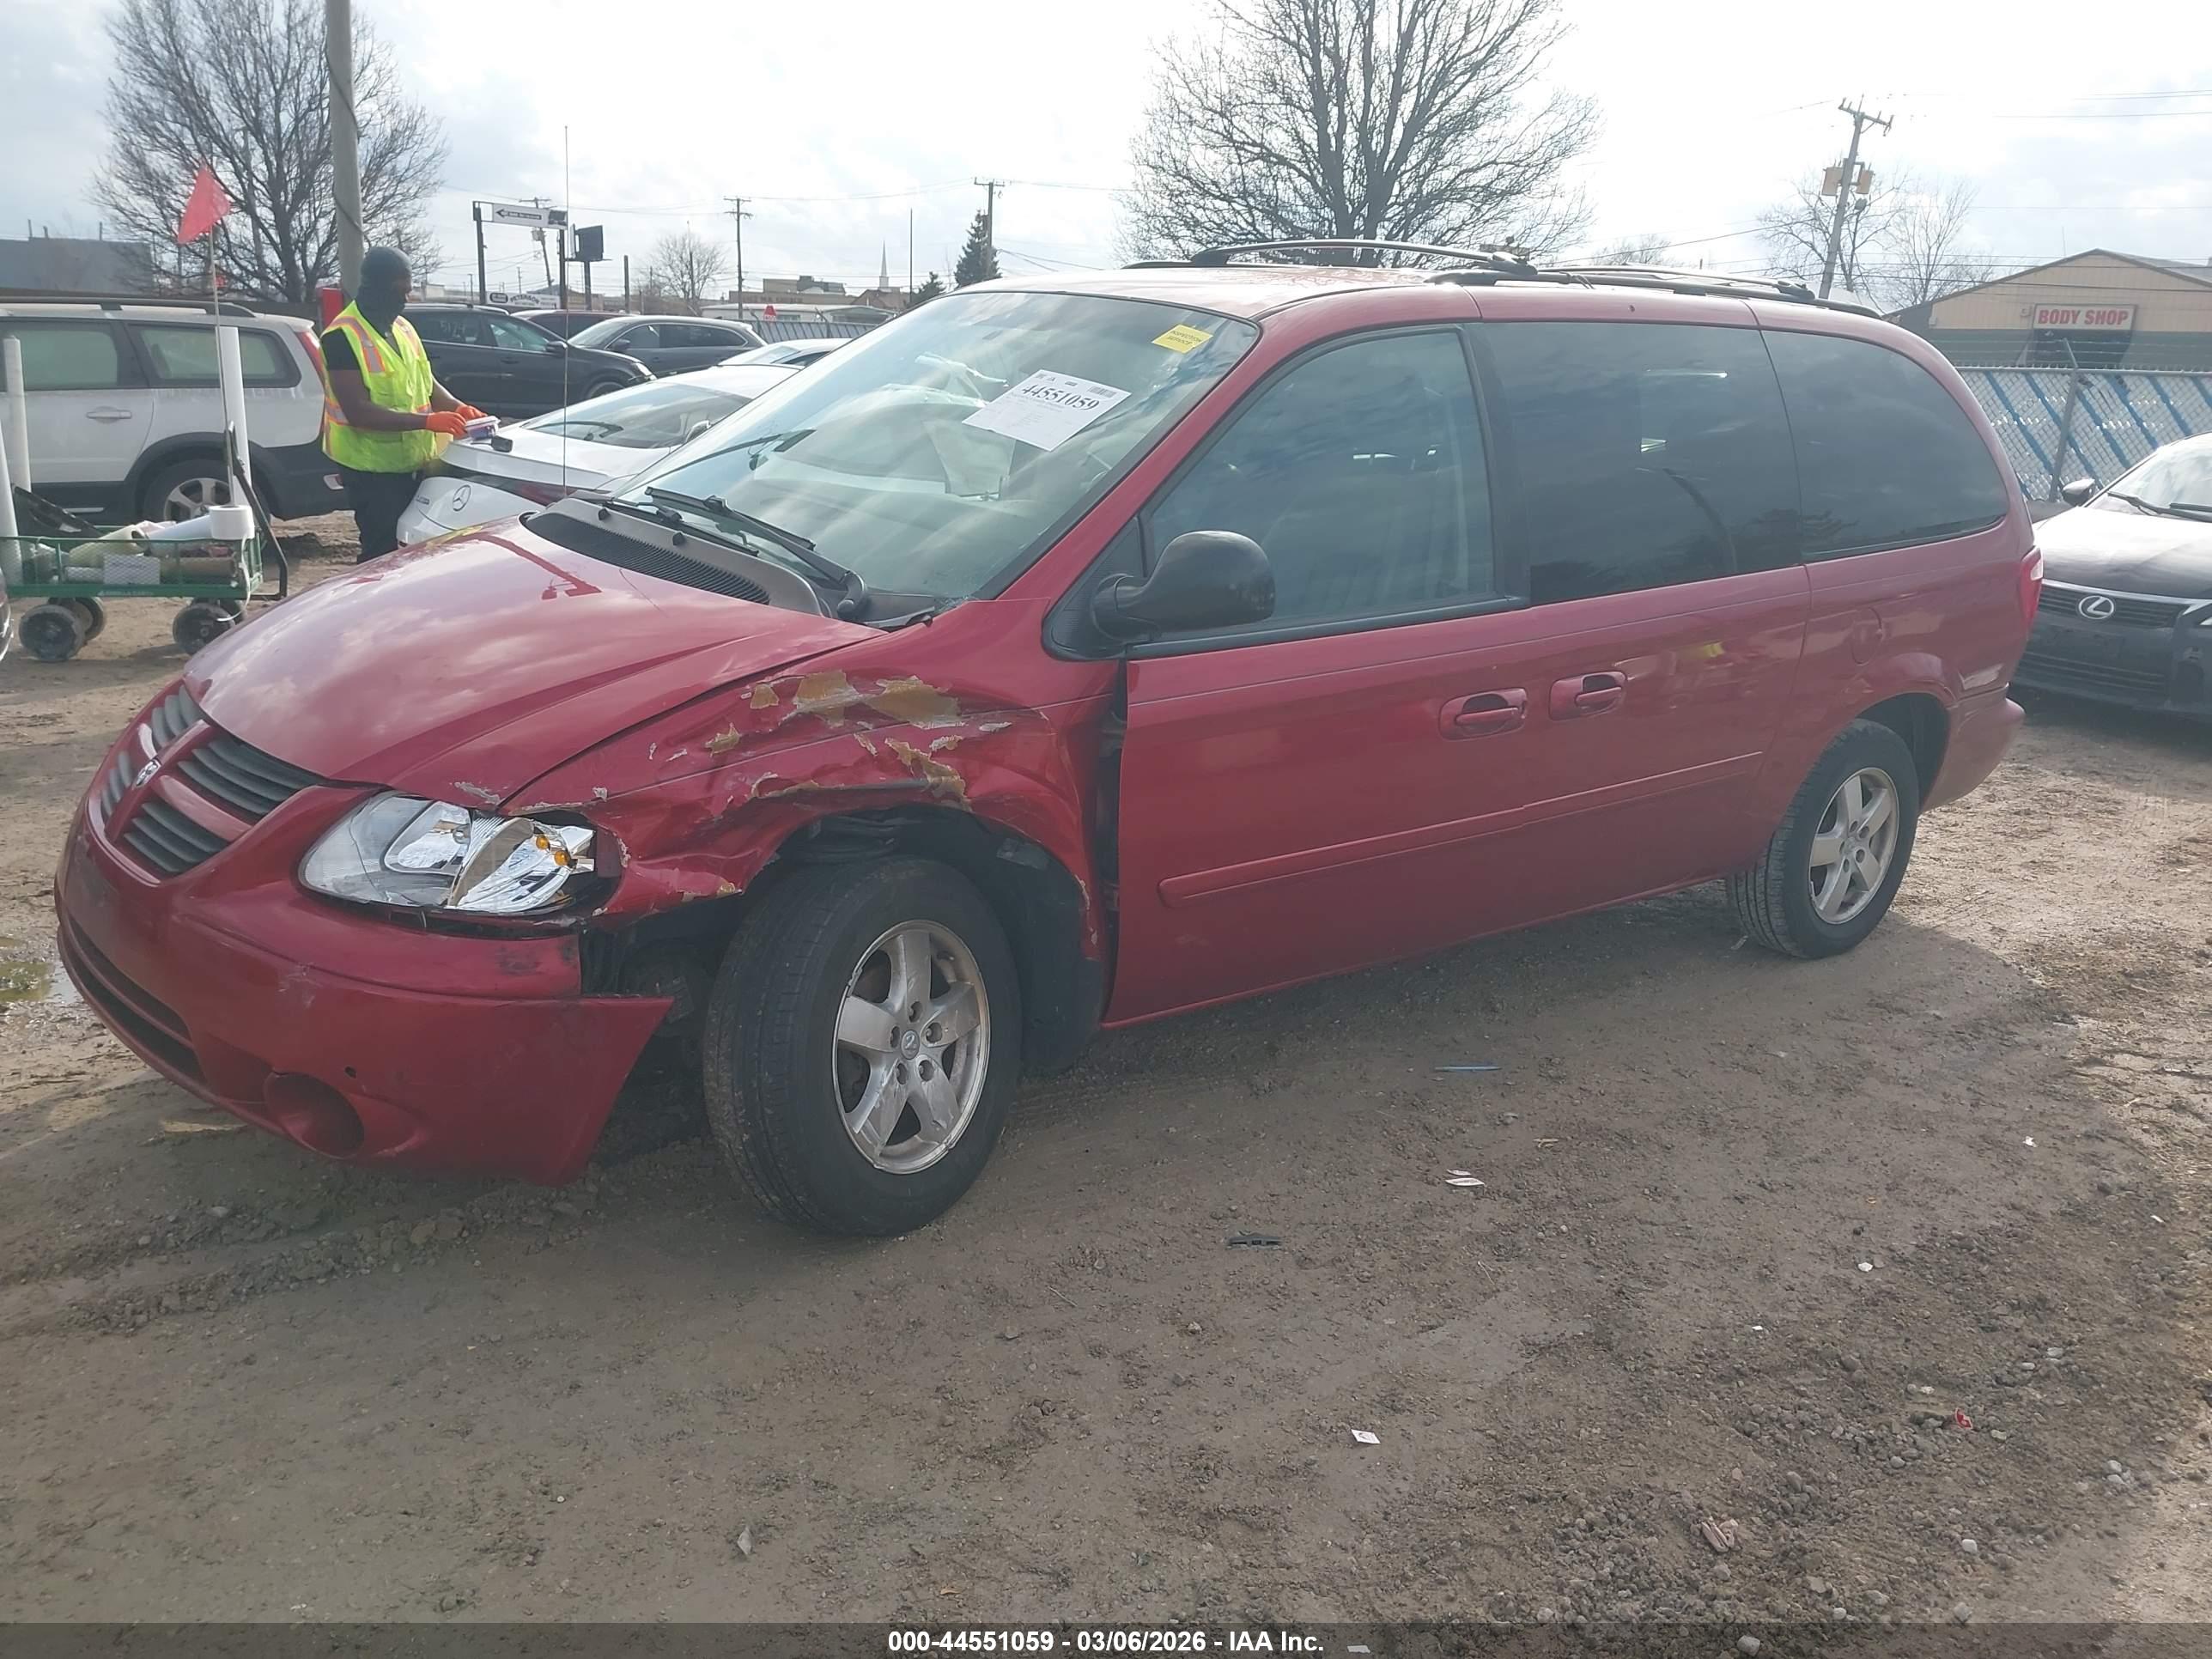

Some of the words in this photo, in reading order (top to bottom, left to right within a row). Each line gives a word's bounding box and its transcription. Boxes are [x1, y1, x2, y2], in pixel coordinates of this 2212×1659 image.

[2038, 309, 2081, 325] BODY
[2084, 310, 2129, 325] SHOP
[1021, 384, 1100, 410] 44551059
